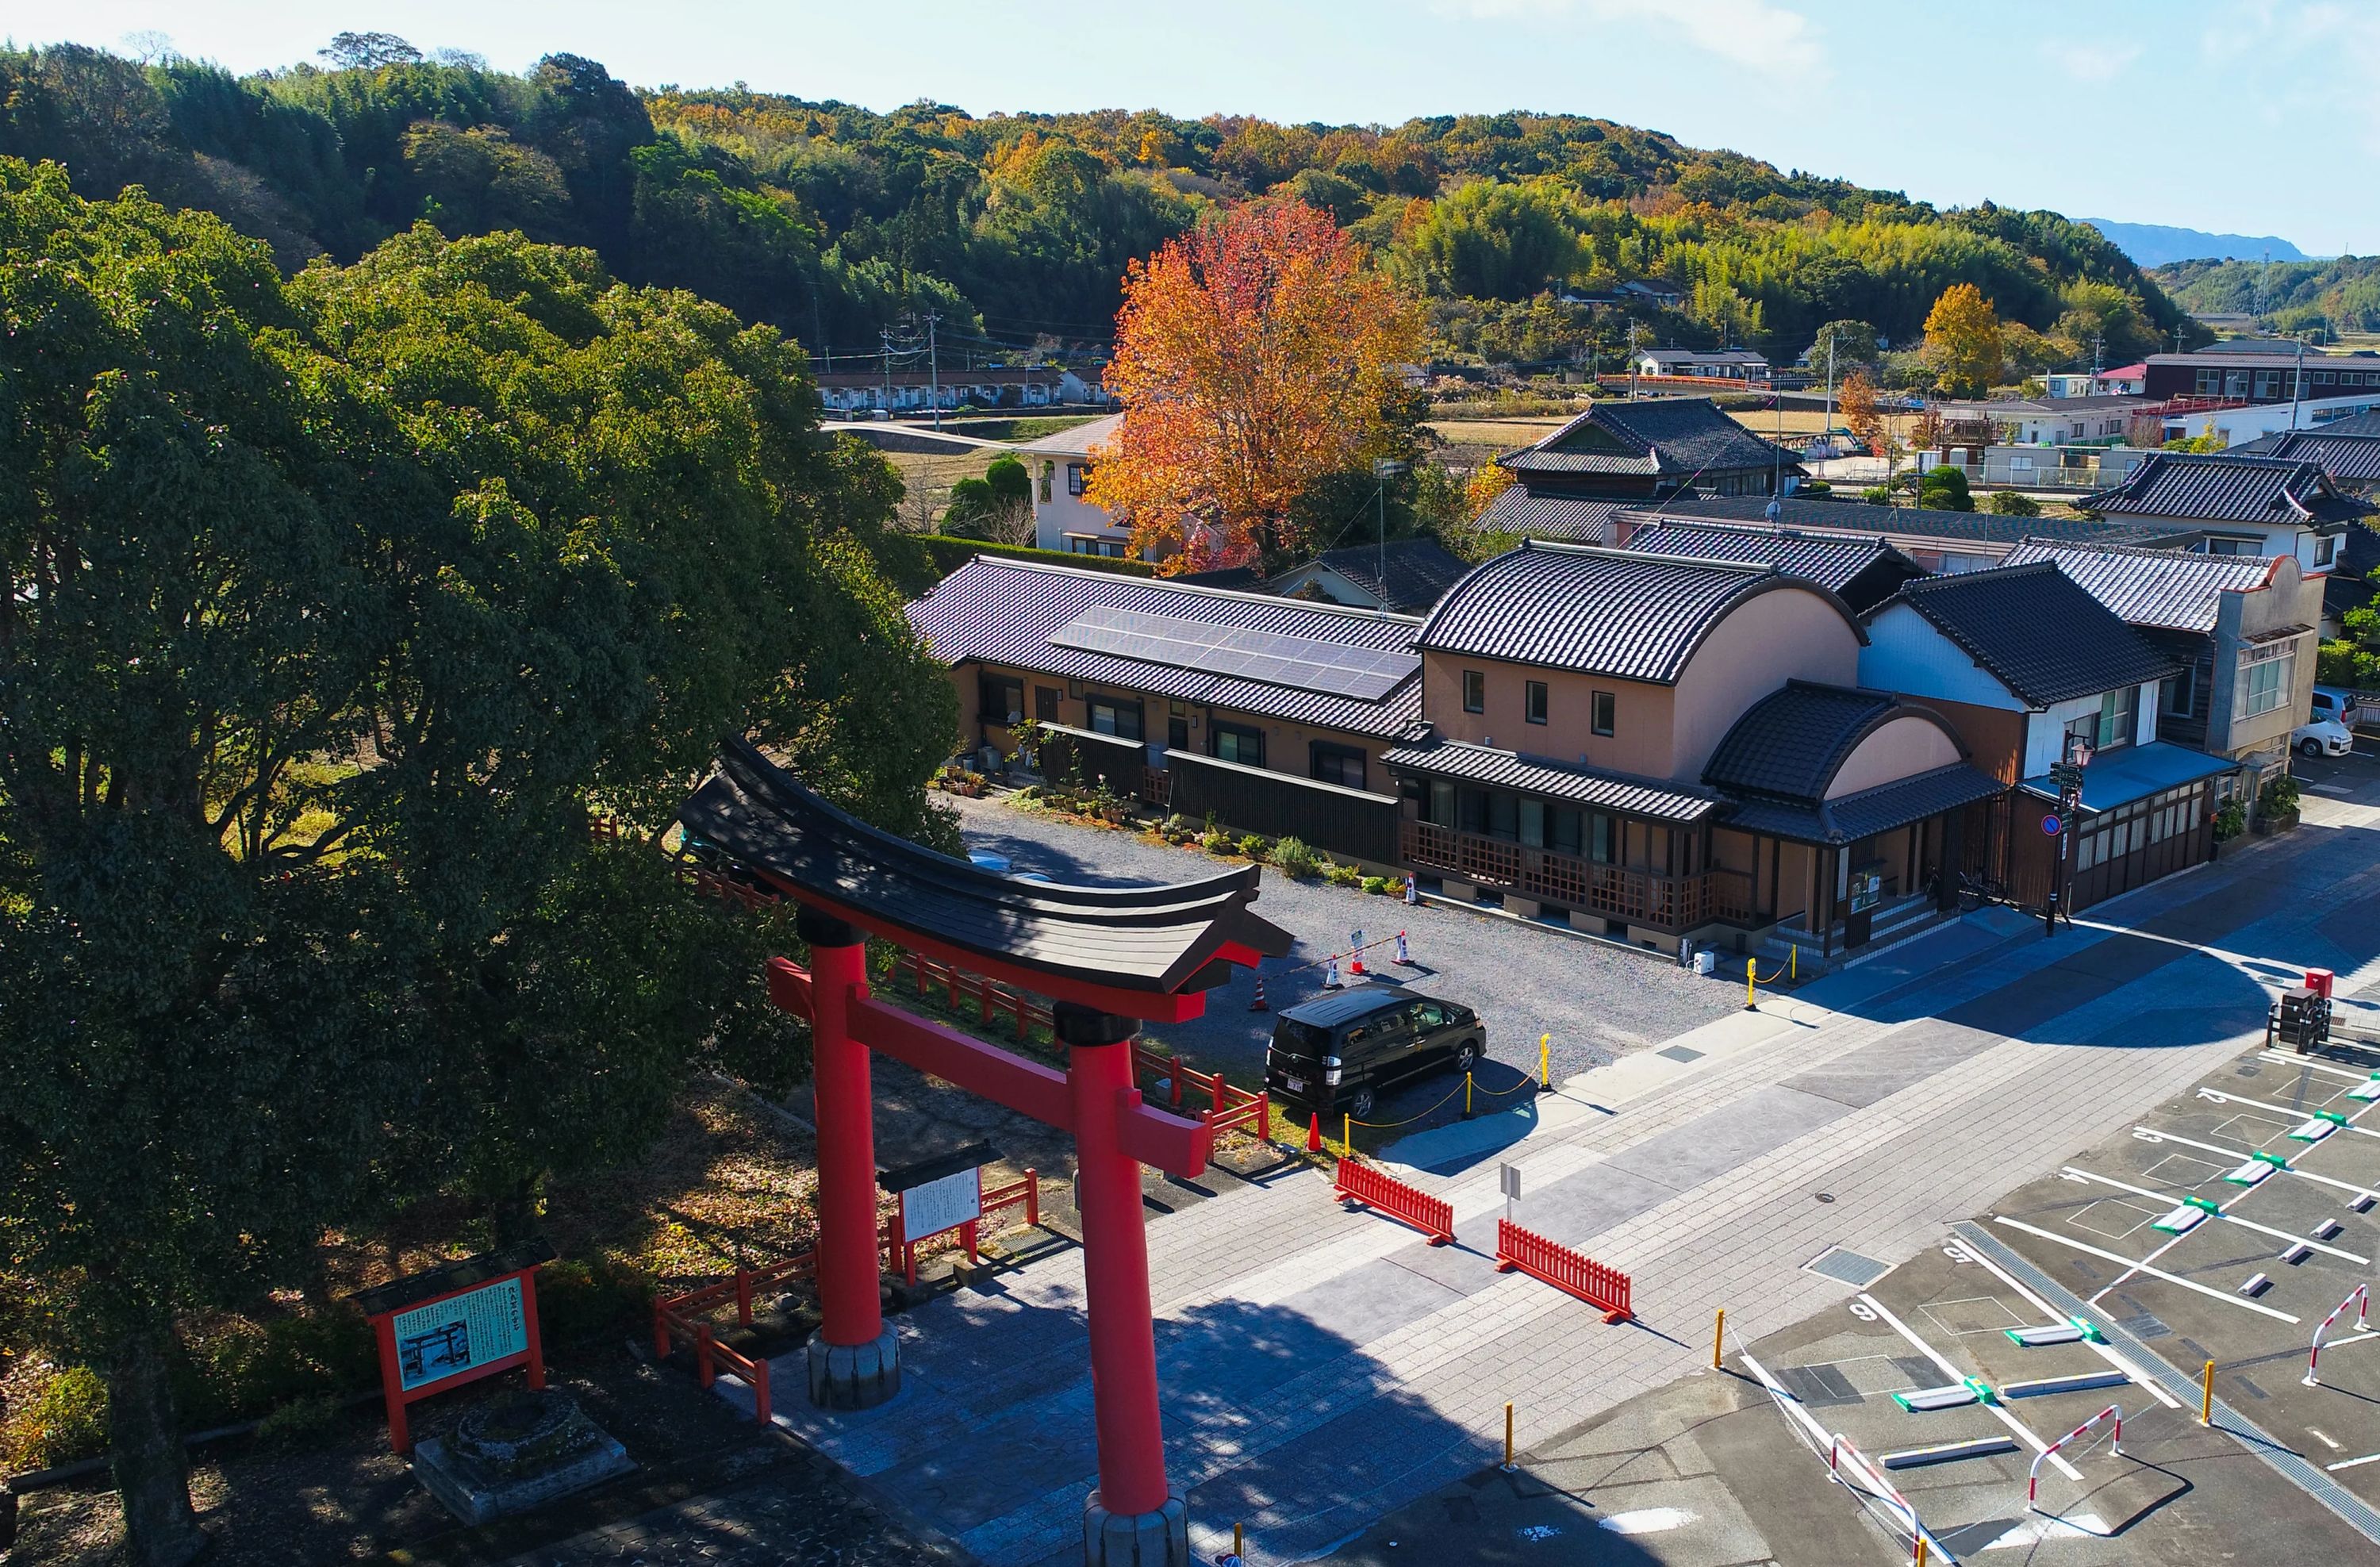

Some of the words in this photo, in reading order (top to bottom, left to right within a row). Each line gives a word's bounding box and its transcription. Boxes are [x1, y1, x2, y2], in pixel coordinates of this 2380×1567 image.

[2196, 1092, 2227, 1104] 2
[2132, 1131, 2163, 1143] 3
[2059, 1173, 2090, 1185] 4
[1943, 1247, 1974, 1263] 5
[1849, 1304, 1878, 1321] 6
